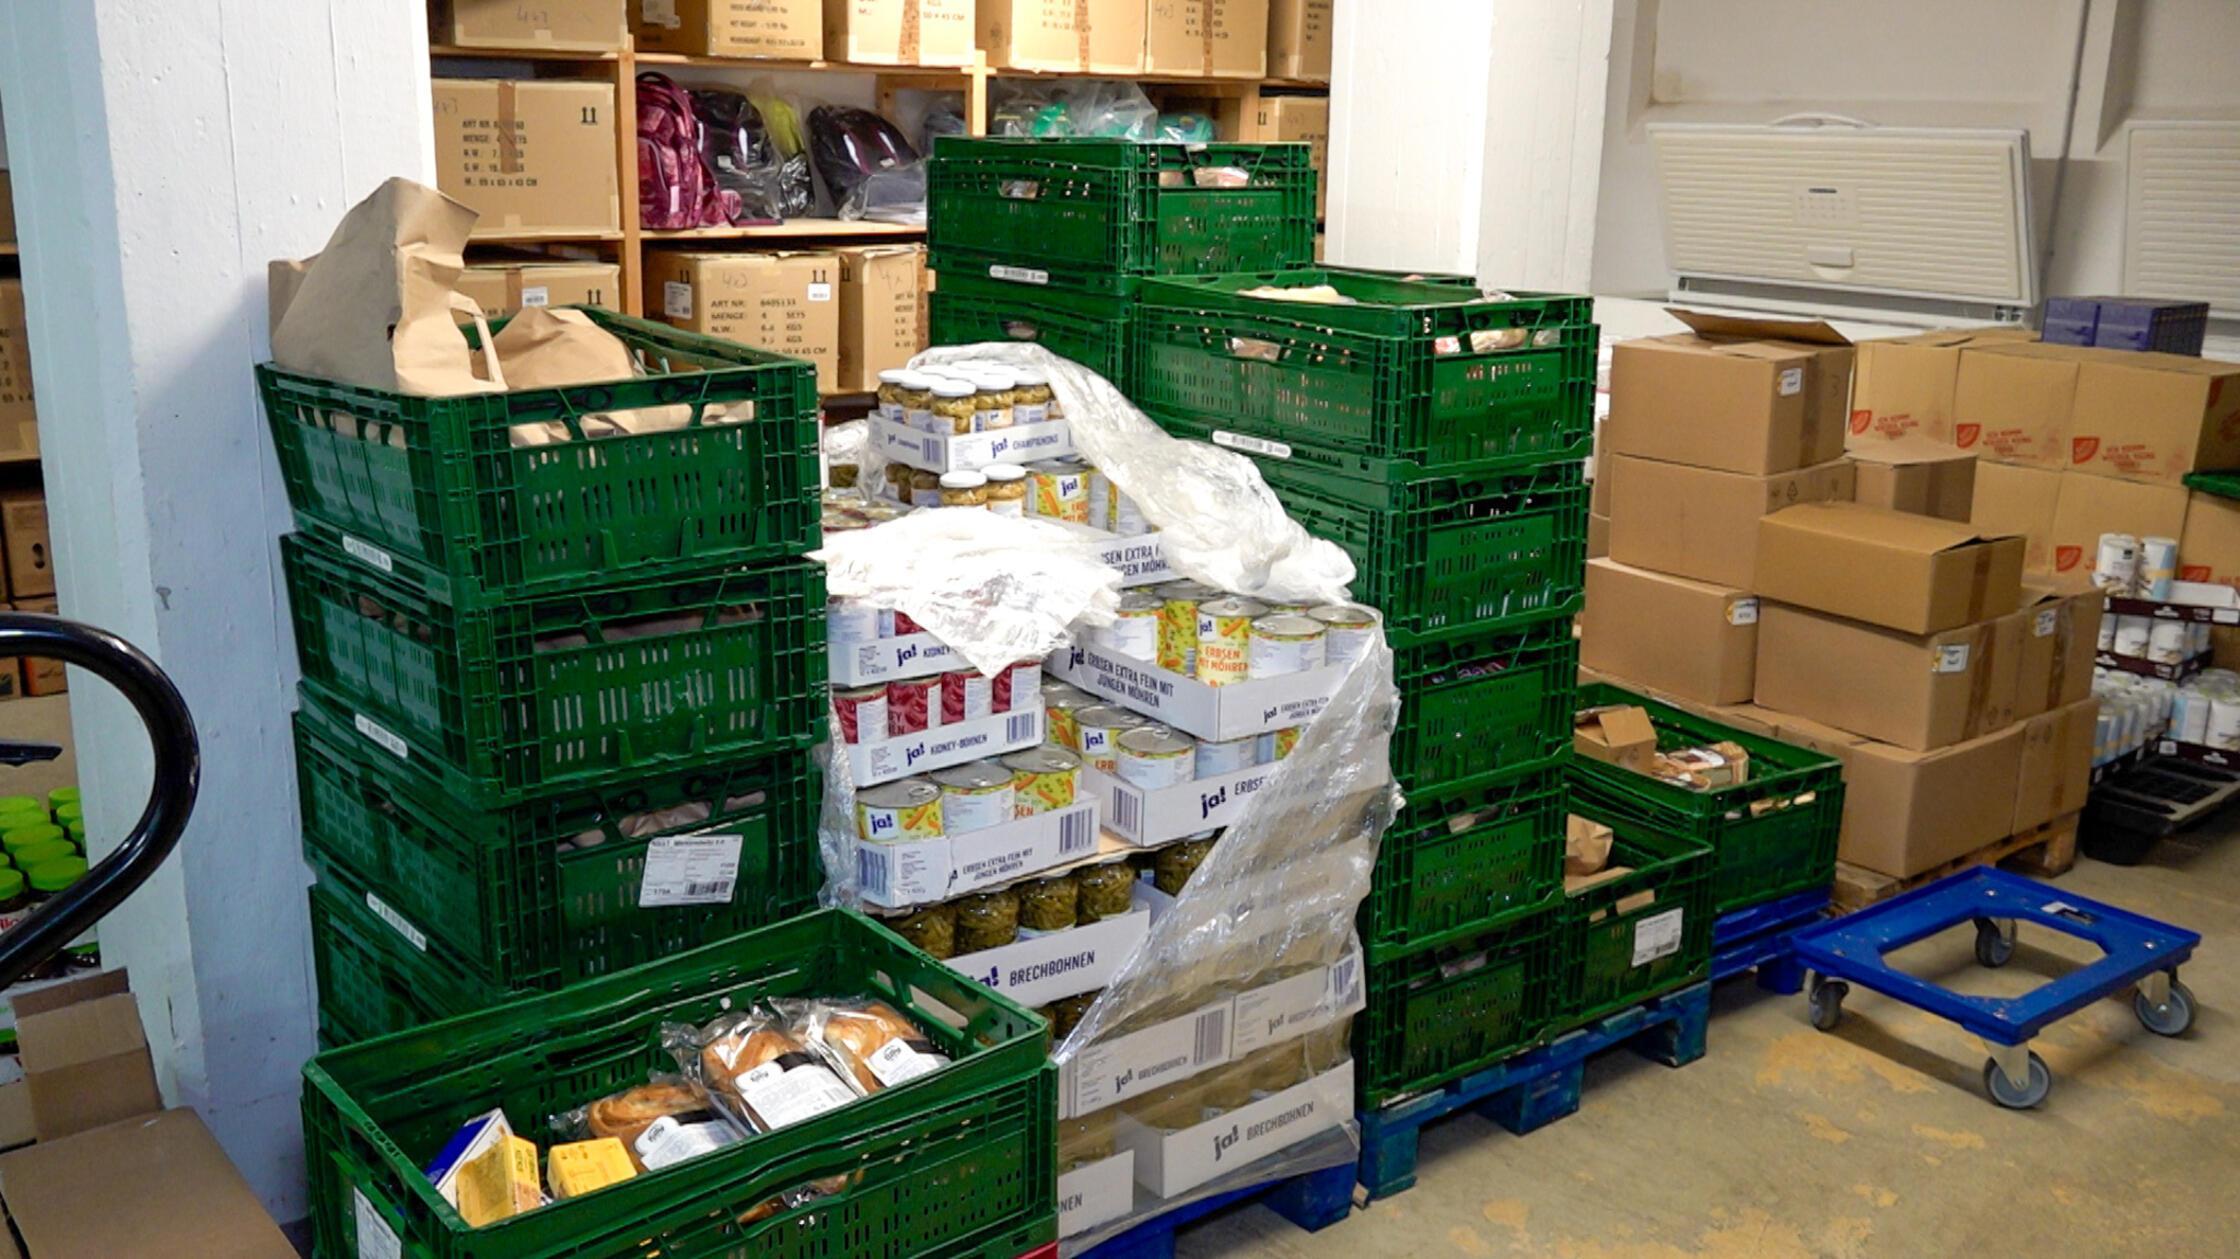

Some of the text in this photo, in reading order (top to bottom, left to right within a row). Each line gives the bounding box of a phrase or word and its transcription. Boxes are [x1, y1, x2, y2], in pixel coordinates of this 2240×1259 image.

[991, 438, 1008, 459] ja!
[1061, 477, 1078, 496] ja!
[1125, 545, 1152, 562] EXTRA
[1199, 620, 1212, 636] ja!
[896, 643, 917, 667] ja!
[1205, 646, 1241, 660] ERBSEN
[1069, 646, 1085, 671] ja!
[1115, 660, 1138, 683] EXTRA
[1140, 672, 1158, 691] FEIN
[1159, 681, 1174, 697] MIT
[1097, 674, 1160, 708] JUNGEN MÖHREN
[1085, 733, 1104, 750] ja!
[906, 742, 925, 767] ja!
[1201, 785, 1226, 819] ja!
[871, 814, 893, 834] ja!
[1010, 950, 1096, 987] BRECHBOHNEN
[1116, 1068, 1133, 1093] ja!
[1214, 1101, 1314, 1161] ja! BRECHBOHNEN
